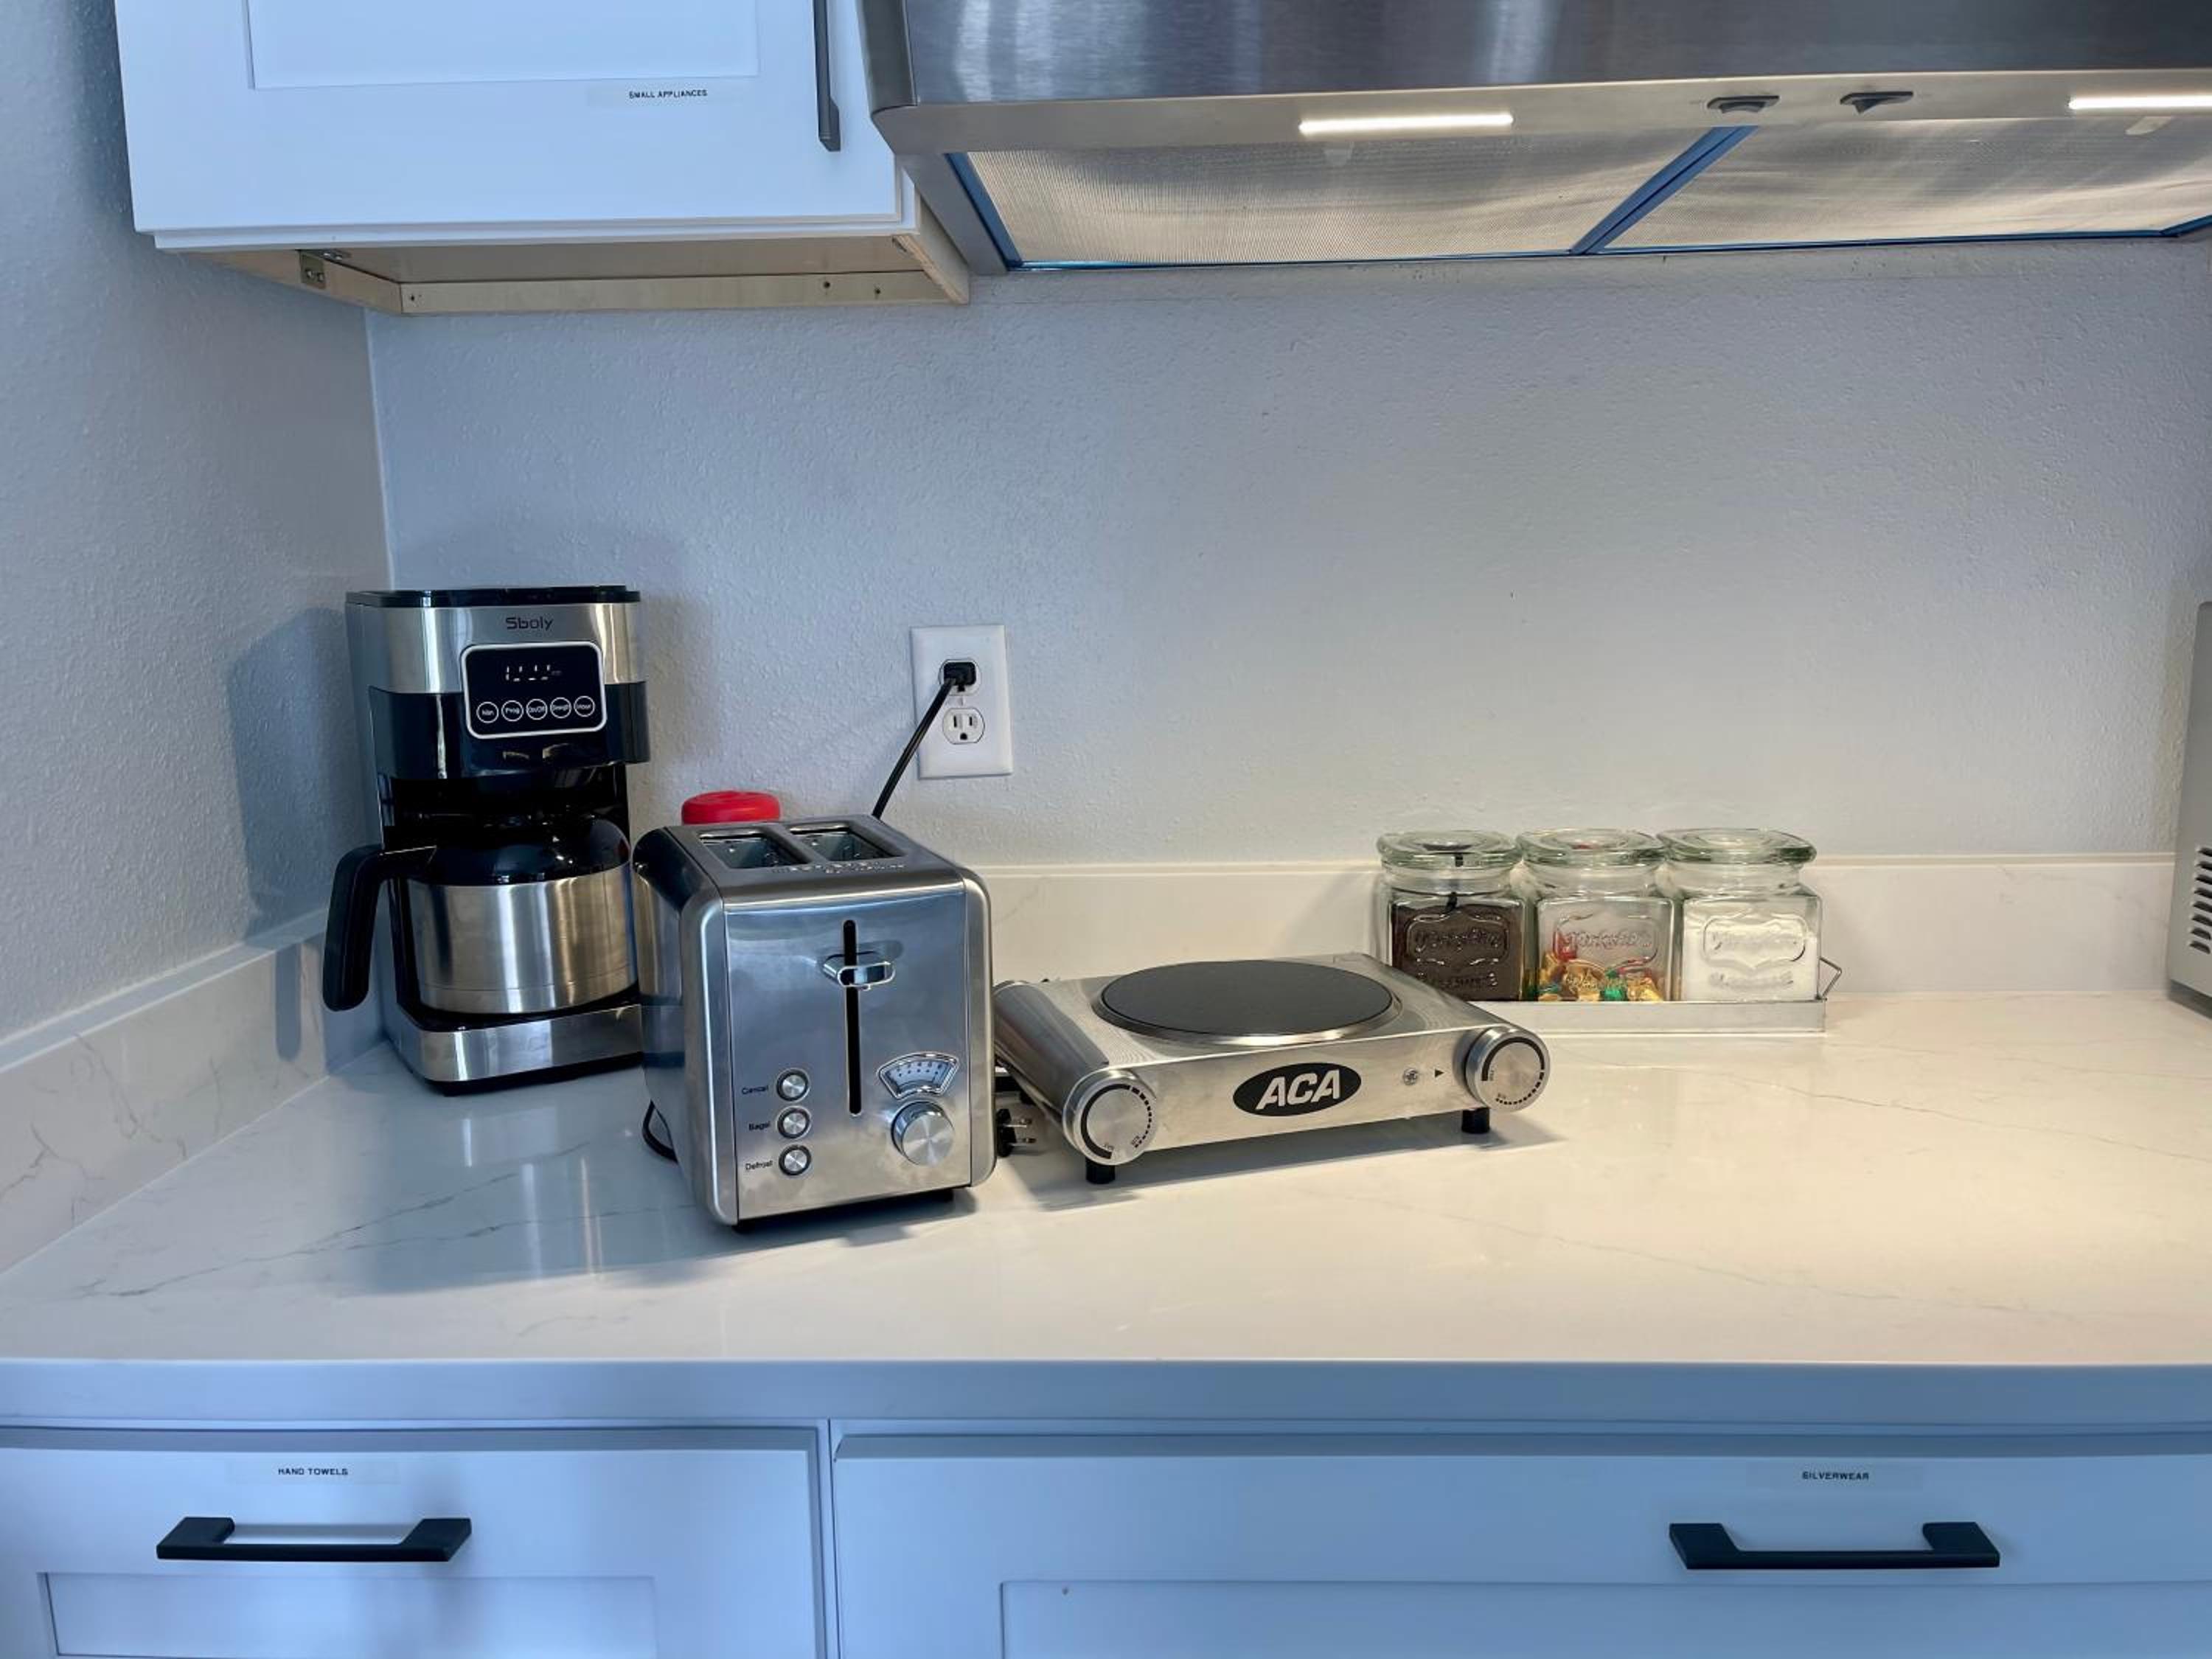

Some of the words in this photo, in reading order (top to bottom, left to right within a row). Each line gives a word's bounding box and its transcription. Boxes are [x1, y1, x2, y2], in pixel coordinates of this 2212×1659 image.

[629, 91, 655, 100] SMALL
[657, 89, 708, 98] APPLIANCES
[506, 616, 554, 630] Sboly
[1255, 1069, 1340, 1110] ACA
[745, 1160, 773, 1170] Defrost
[1802, 1471, 1869, 1480] SILVERWEAR
